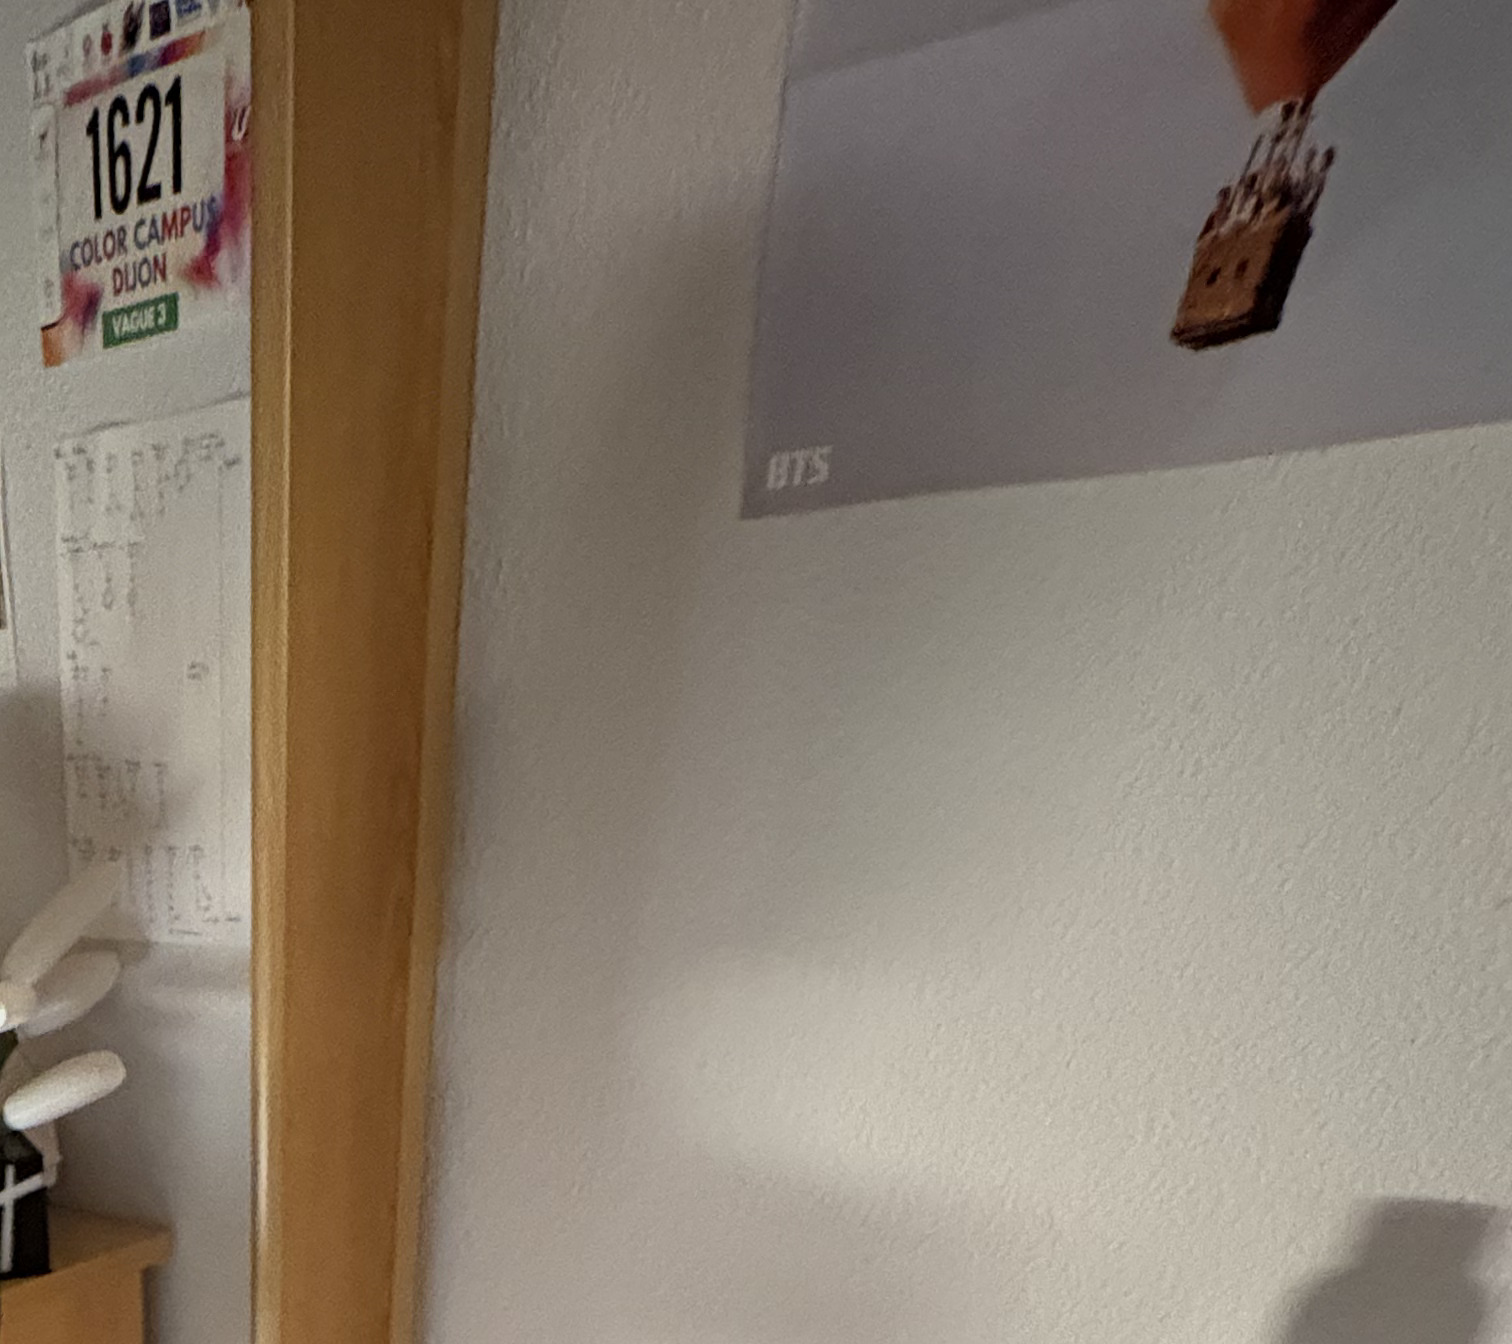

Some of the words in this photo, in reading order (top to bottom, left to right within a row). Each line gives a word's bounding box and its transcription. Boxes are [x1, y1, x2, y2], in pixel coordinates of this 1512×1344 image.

[86, 74, 183, 220] 1621
[69, 226, 128, 272] COLOR
[112, 252, 168, 297] DIJON
[111, 305, 156, 339] VAGUE
[156, 301, 167, 324] 3
[766, 444, 833, 491] BTS
